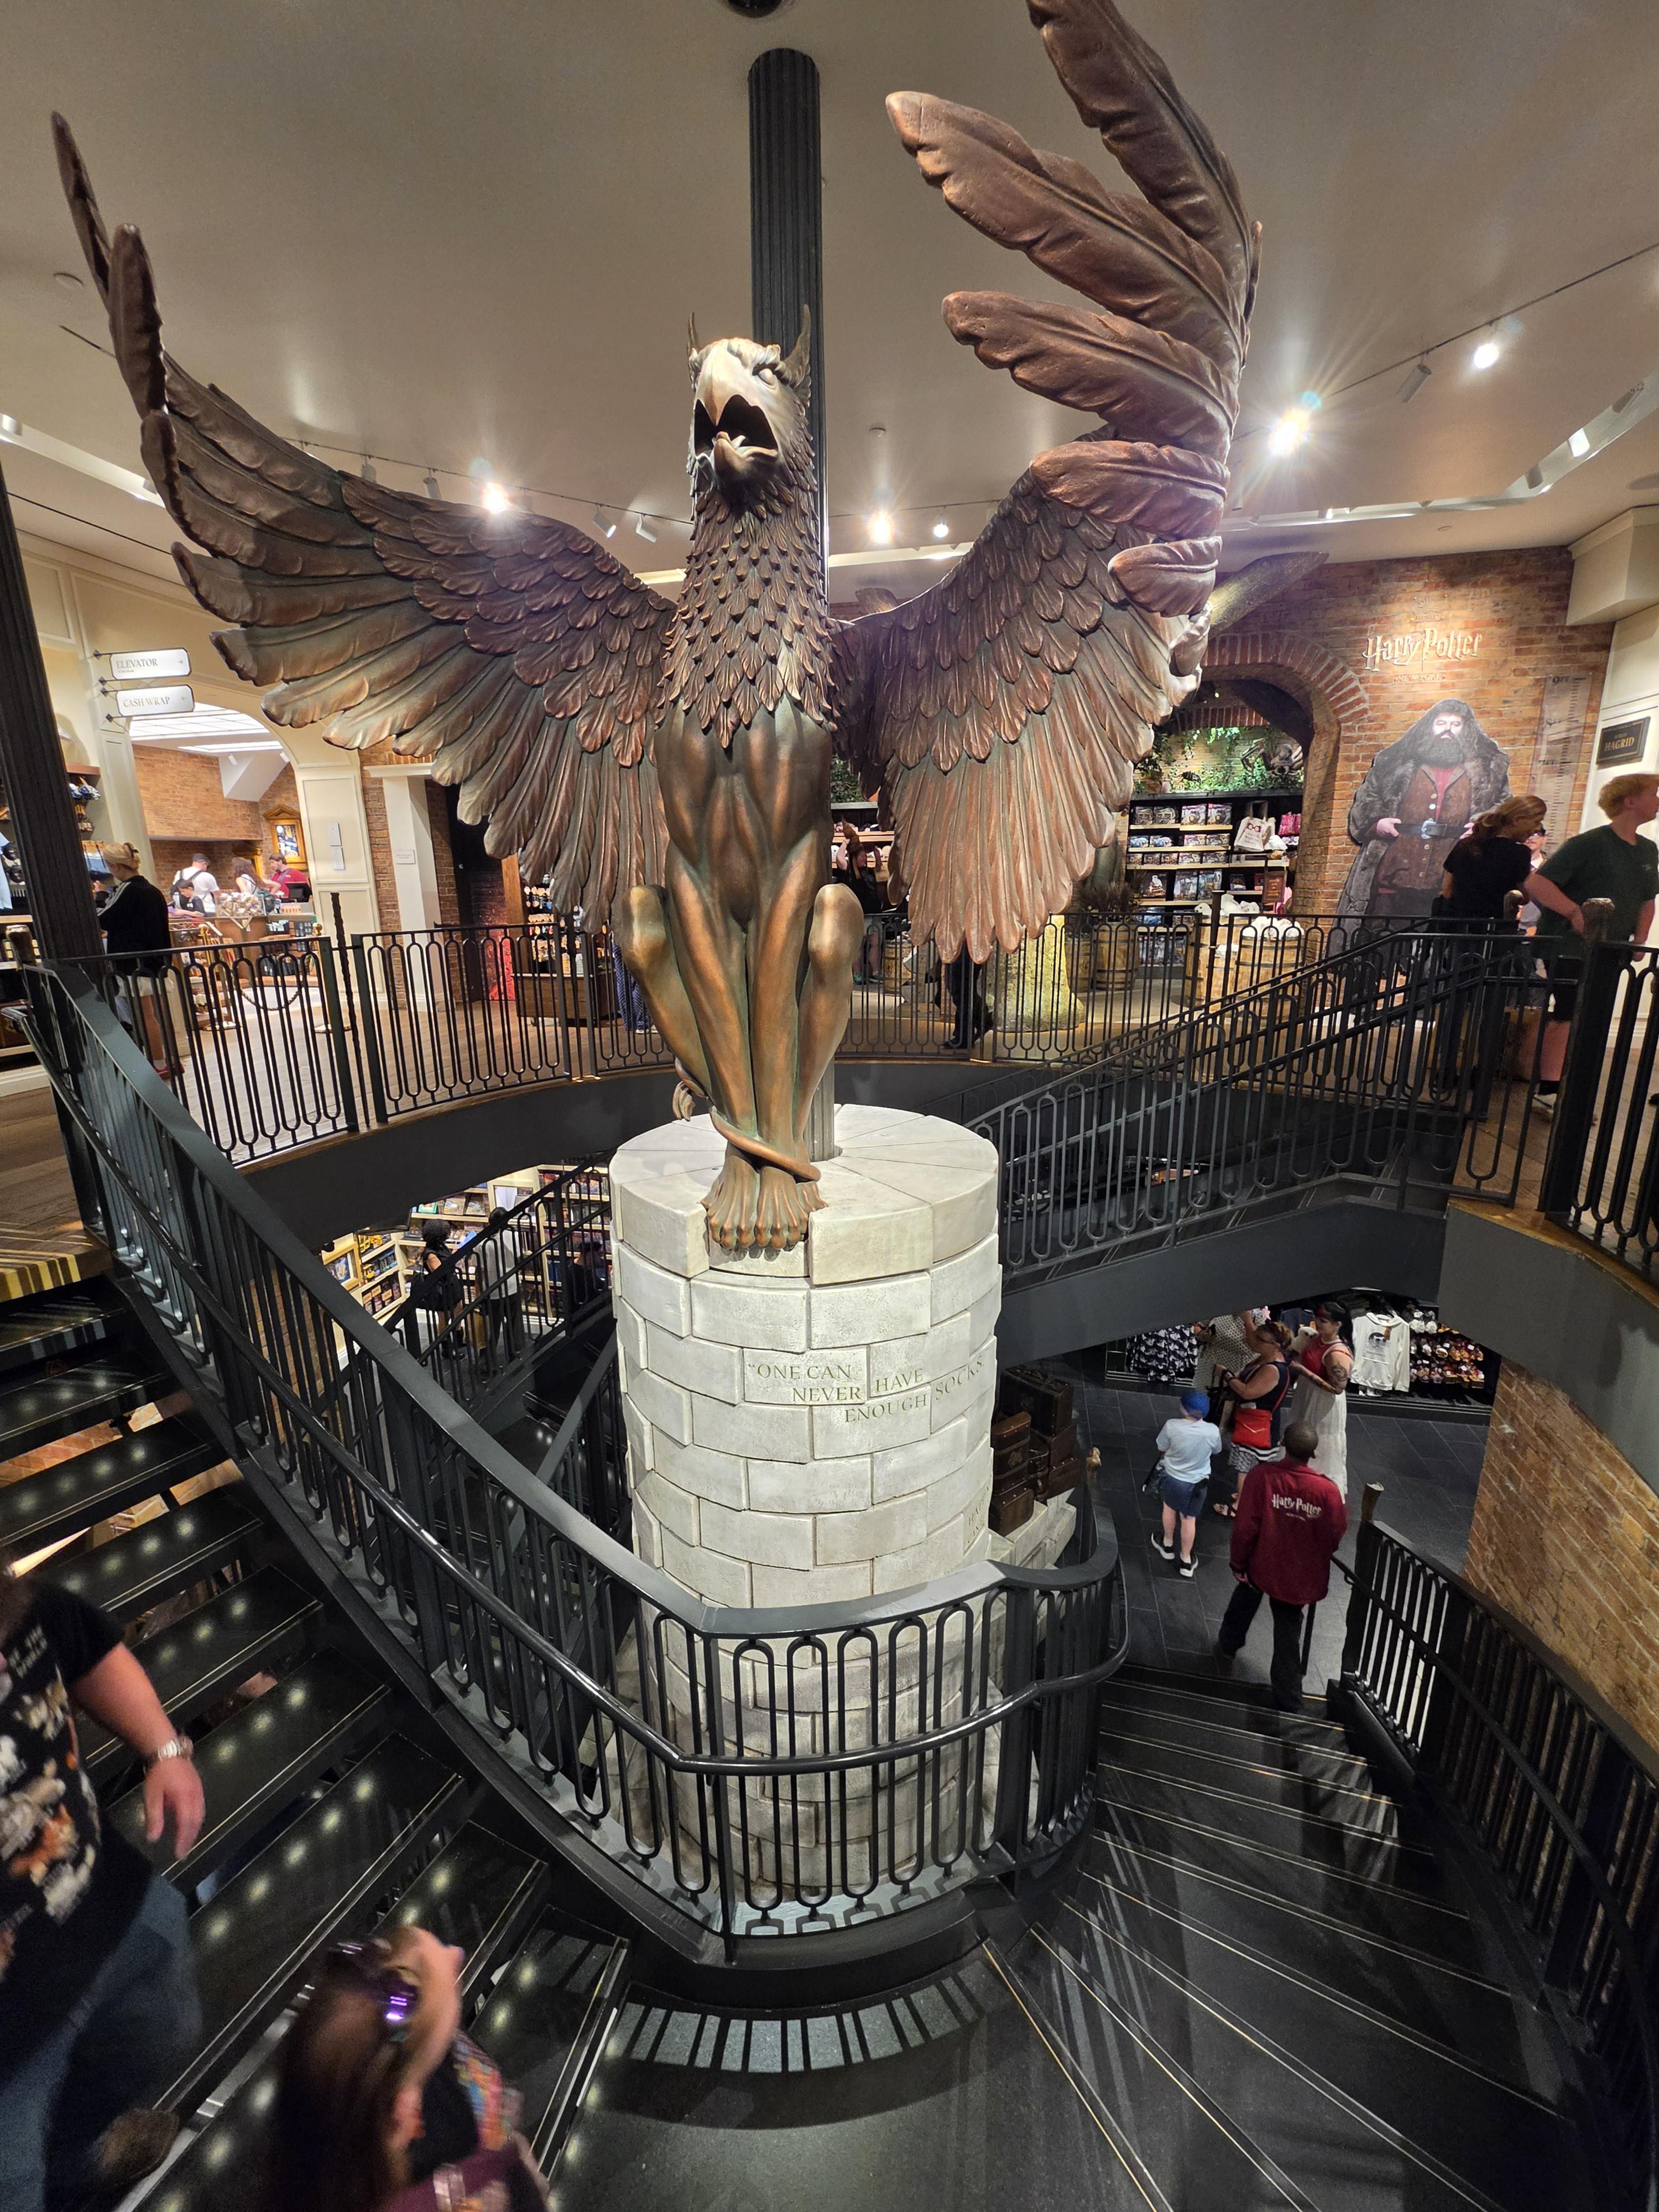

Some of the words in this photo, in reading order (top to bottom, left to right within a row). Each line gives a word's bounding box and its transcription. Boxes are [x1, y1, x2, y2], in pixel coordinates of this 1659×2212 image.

[1362, 635, 1422, 672] Harry
[1422, 628, 1483, 672] Potter
[116, 658, 158, 669] ELEVATOR
[123, 698, 144, 707] CASH
[147, 696, 170, 706] WRAP
[1605, 737, 1635, 752] HAGRID
[807, 1365, 853, 1379] CAN
[792, 1386, 861, 1401] NEVER
[876, 1368, 923, 1392] HAVE
[845, 1394, 927, 1422] ENOUGH
[1271, 1494, 1295, 1509] Harry
[1296, 1498, 1322, 1515] Potter
